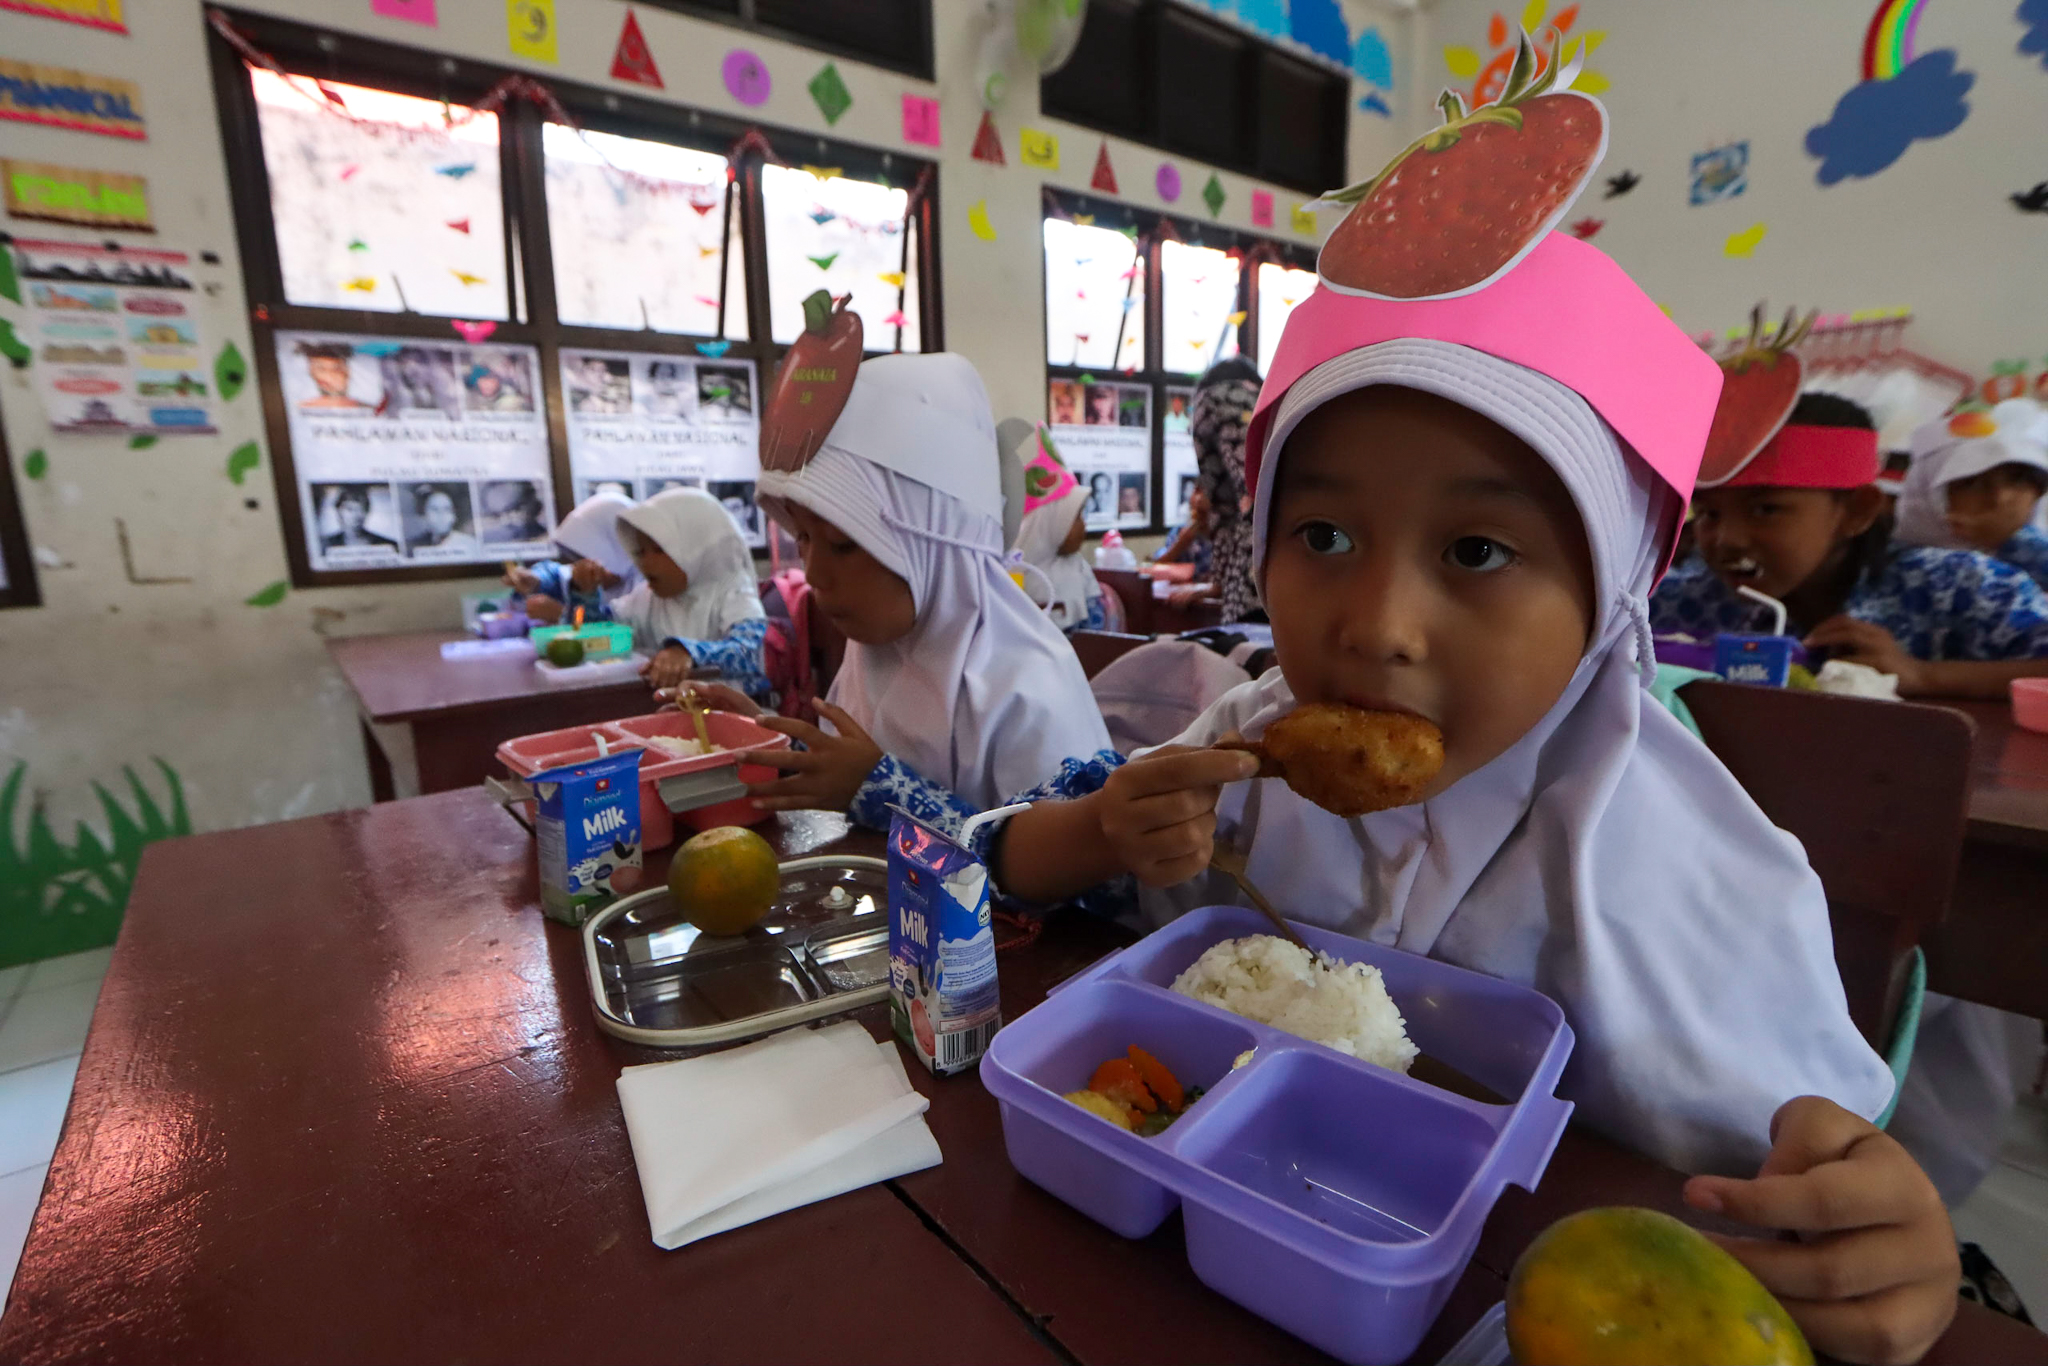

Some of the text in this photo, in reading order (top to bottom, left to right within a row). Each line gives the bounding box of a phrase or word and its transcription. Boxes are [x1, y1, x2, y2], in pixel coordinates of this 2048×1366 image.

[1727, 663, 1770, 680] Milk
[582, 806, 627, 841] Milk
[900, 906, 928, 950] Milk
